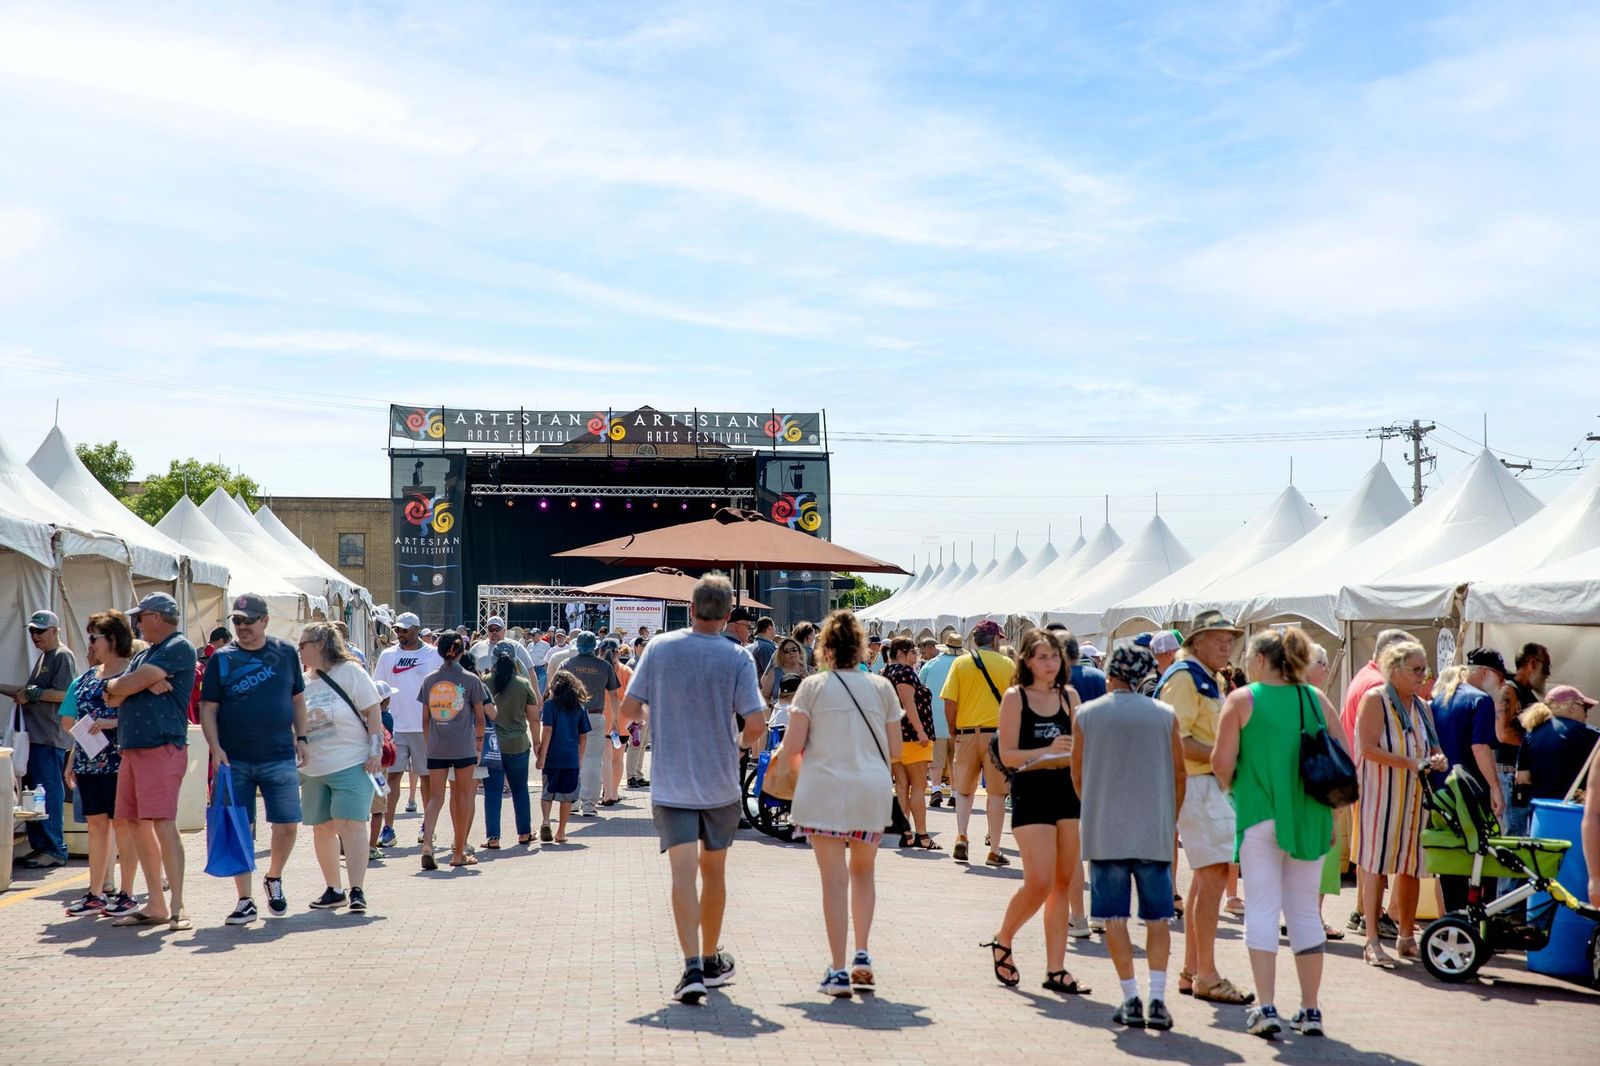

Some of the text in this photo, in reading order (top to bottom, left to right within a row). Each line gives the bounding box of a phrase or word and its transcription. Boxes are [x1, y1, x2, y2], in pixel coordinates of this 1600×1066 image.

[455, 412, 582, 426] ARTESIAN
[634, 414, 760, 428] ARTESIAN
[468, 430, 571, 442] ARTS FESTIVAL
[647, 431, 750, 444] ARTS FESTIVAL
[394, 537, 460, 546] ARTESIAN
[401, 546, 454, 554] ARTS FESTIVAL
[397, 657, 419, 667] NIKE
